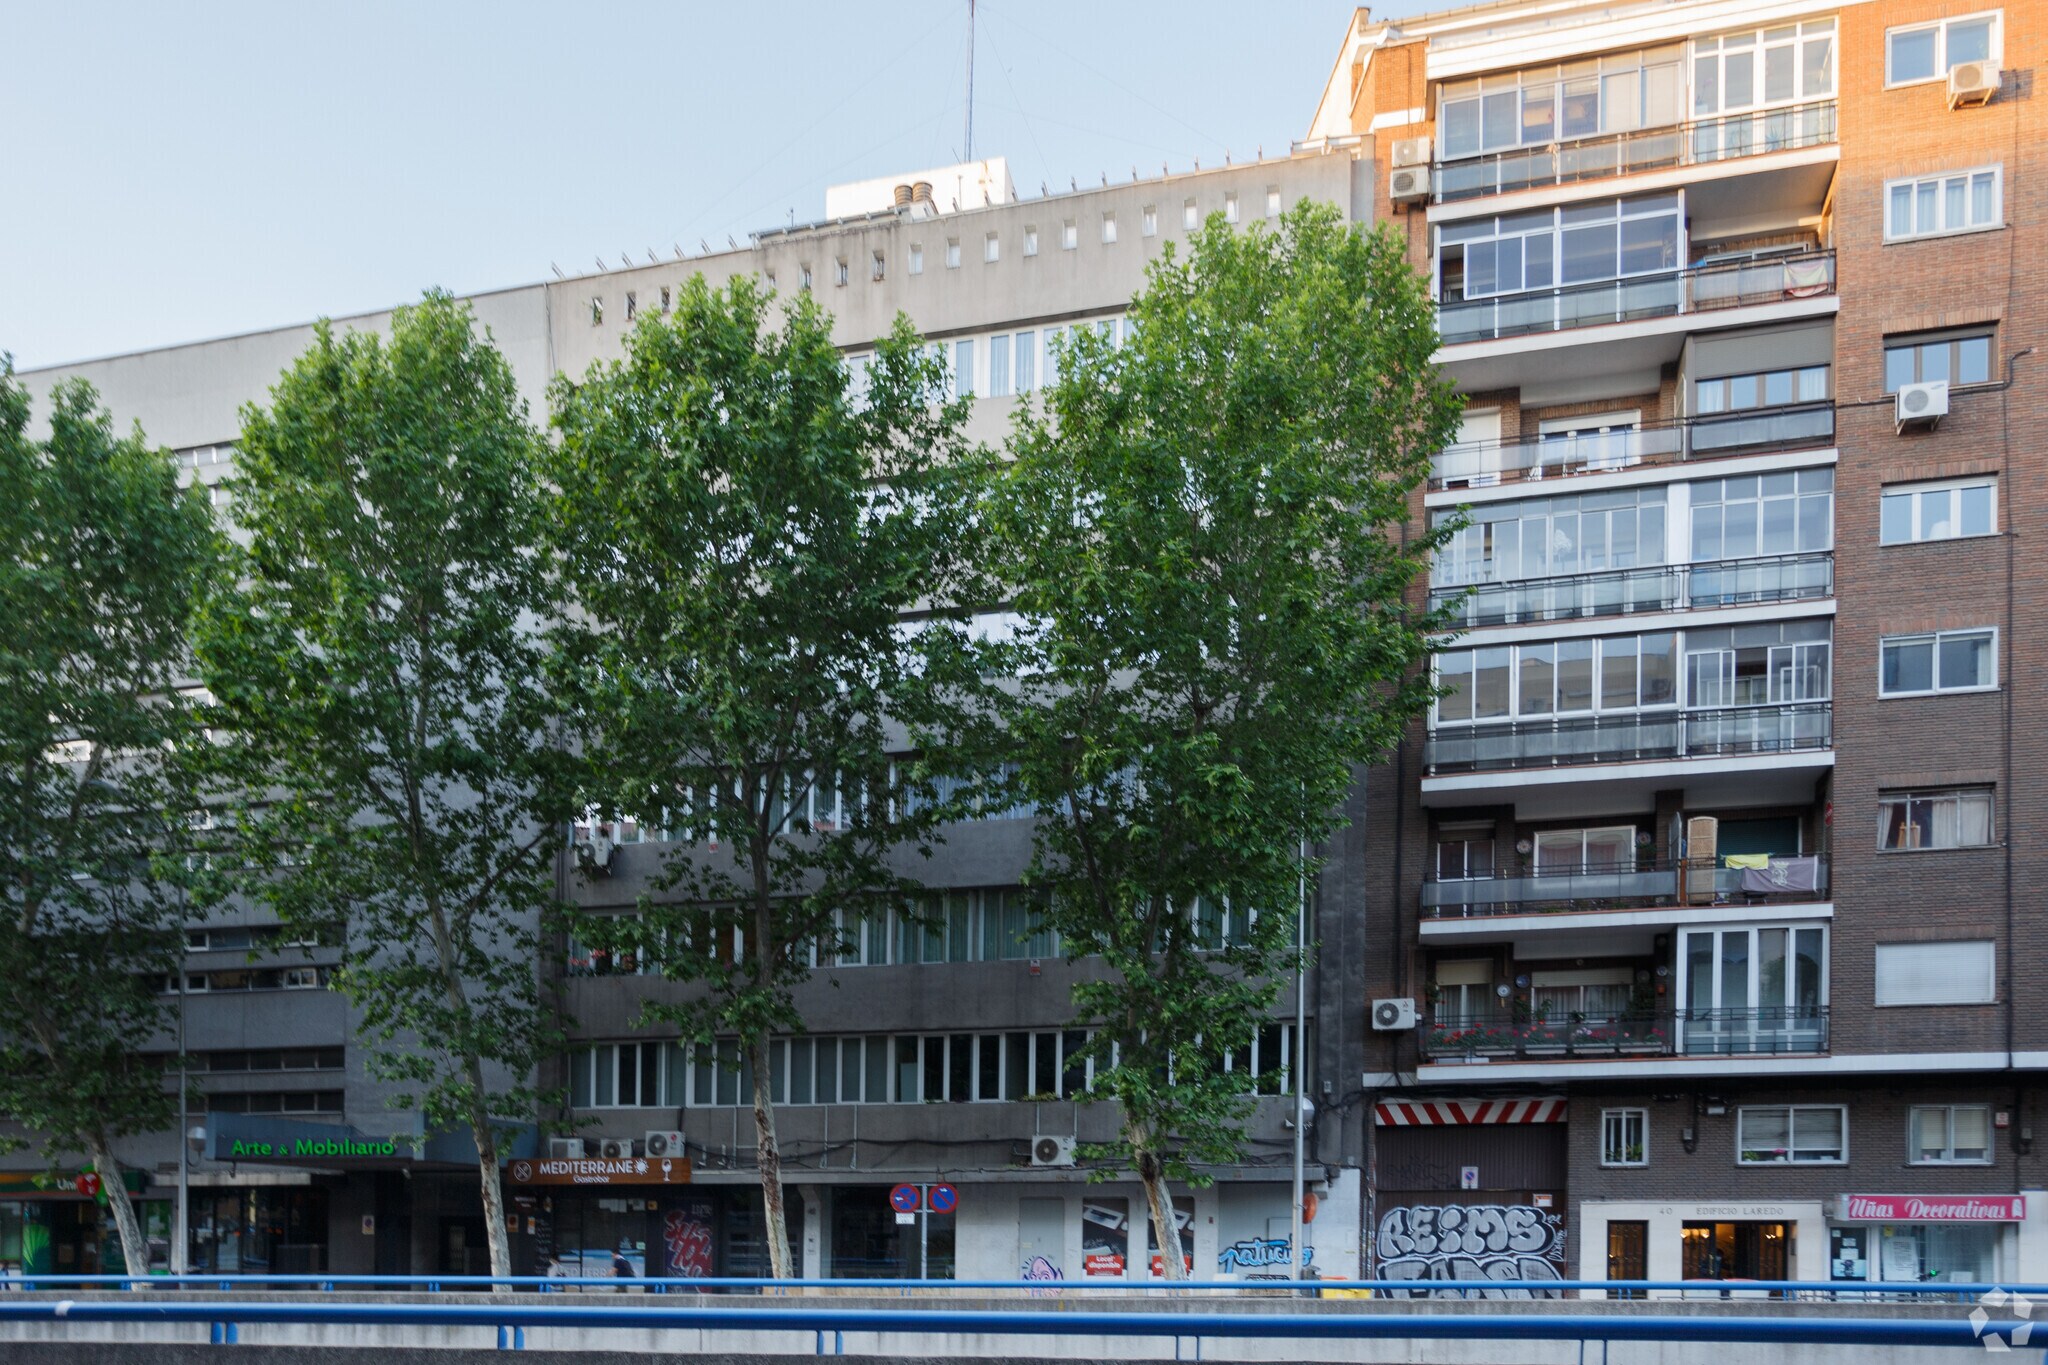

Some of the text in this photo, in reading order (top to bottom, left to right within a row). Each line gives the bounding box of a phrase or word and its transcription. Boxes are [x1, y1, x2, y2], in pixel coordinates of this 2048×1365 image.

[231, 1137, 395, 1156] Arte & Mobiliario
[1659, 1207, 1784, 1216] 40 EDIFICIO LAREDO
[1849, 1198, 2006, 1218] Uñas Decorativas
